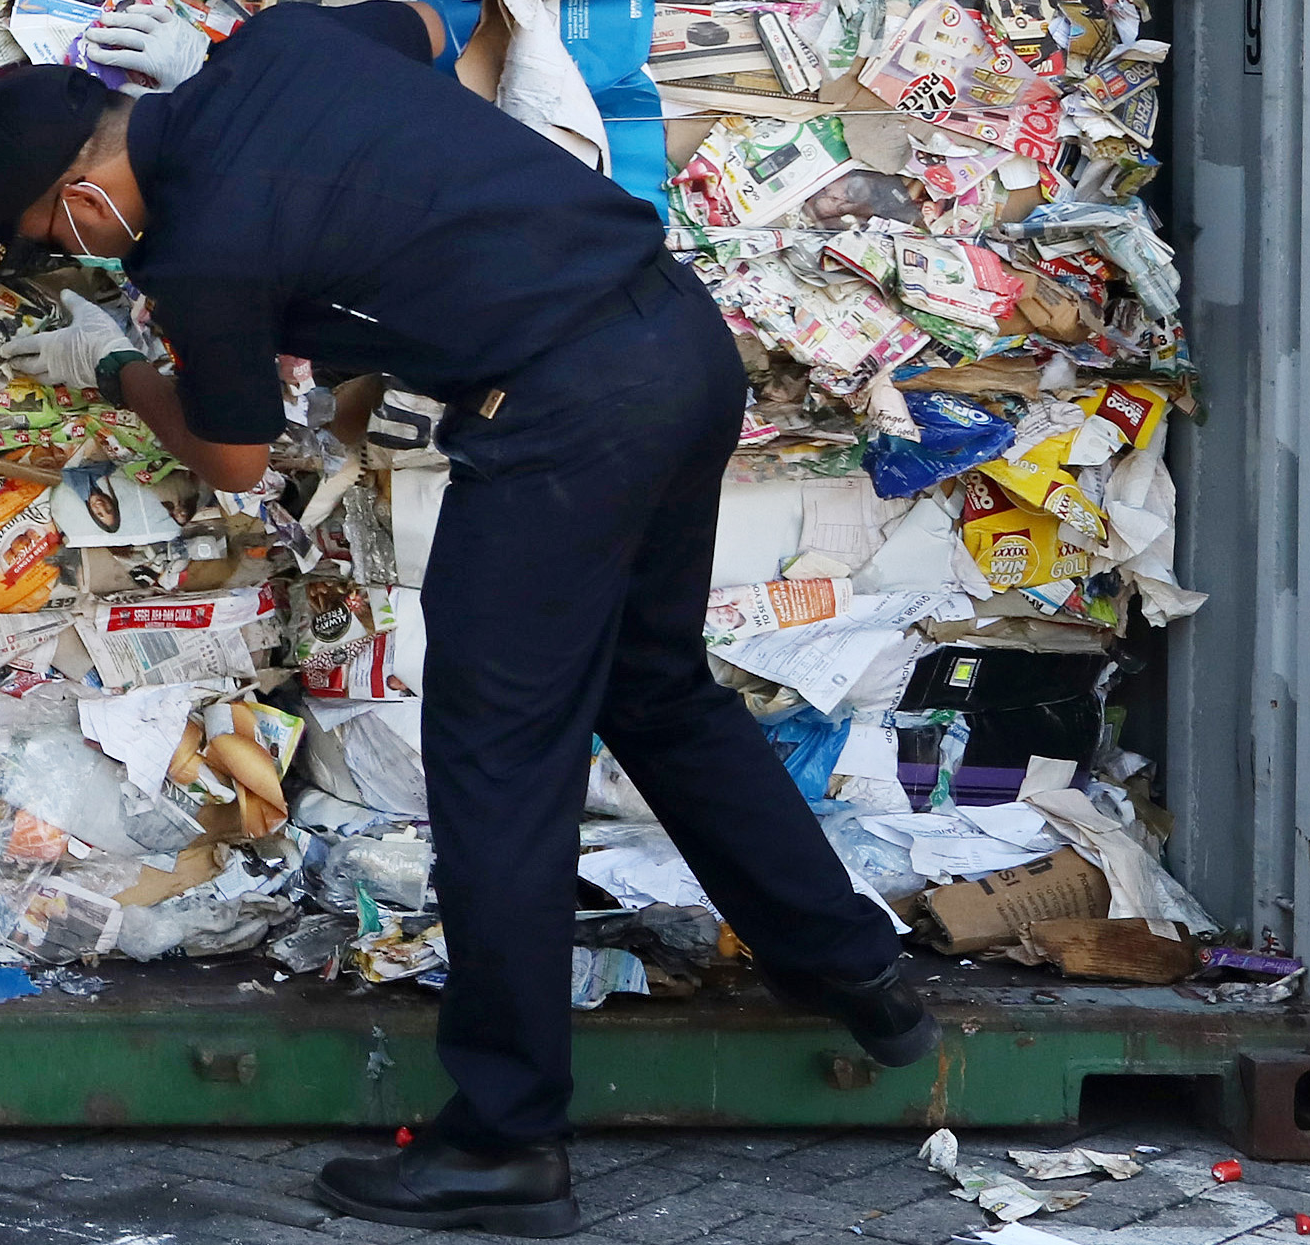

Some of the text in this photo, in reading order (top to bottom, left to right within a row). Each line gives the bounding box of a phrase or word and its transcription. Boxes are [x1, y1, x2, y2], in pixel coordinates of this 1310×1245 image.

[897, 72, 941, 111] PRICE
[877, 408, 907, 426] Finger
[13, 541, 49, 574] GINGER BEER
[990, 559, 1027, 573] WIN
[315, 607, 344, 623] FRESH
[757, 599, 771, 625] TO SEE
[773, 590, 786, 623] Aged Care
[781, 603, 792, 621] Where
[314, 613, 347, 633] ALWAYS
[751, 614, 764, 628] WE
